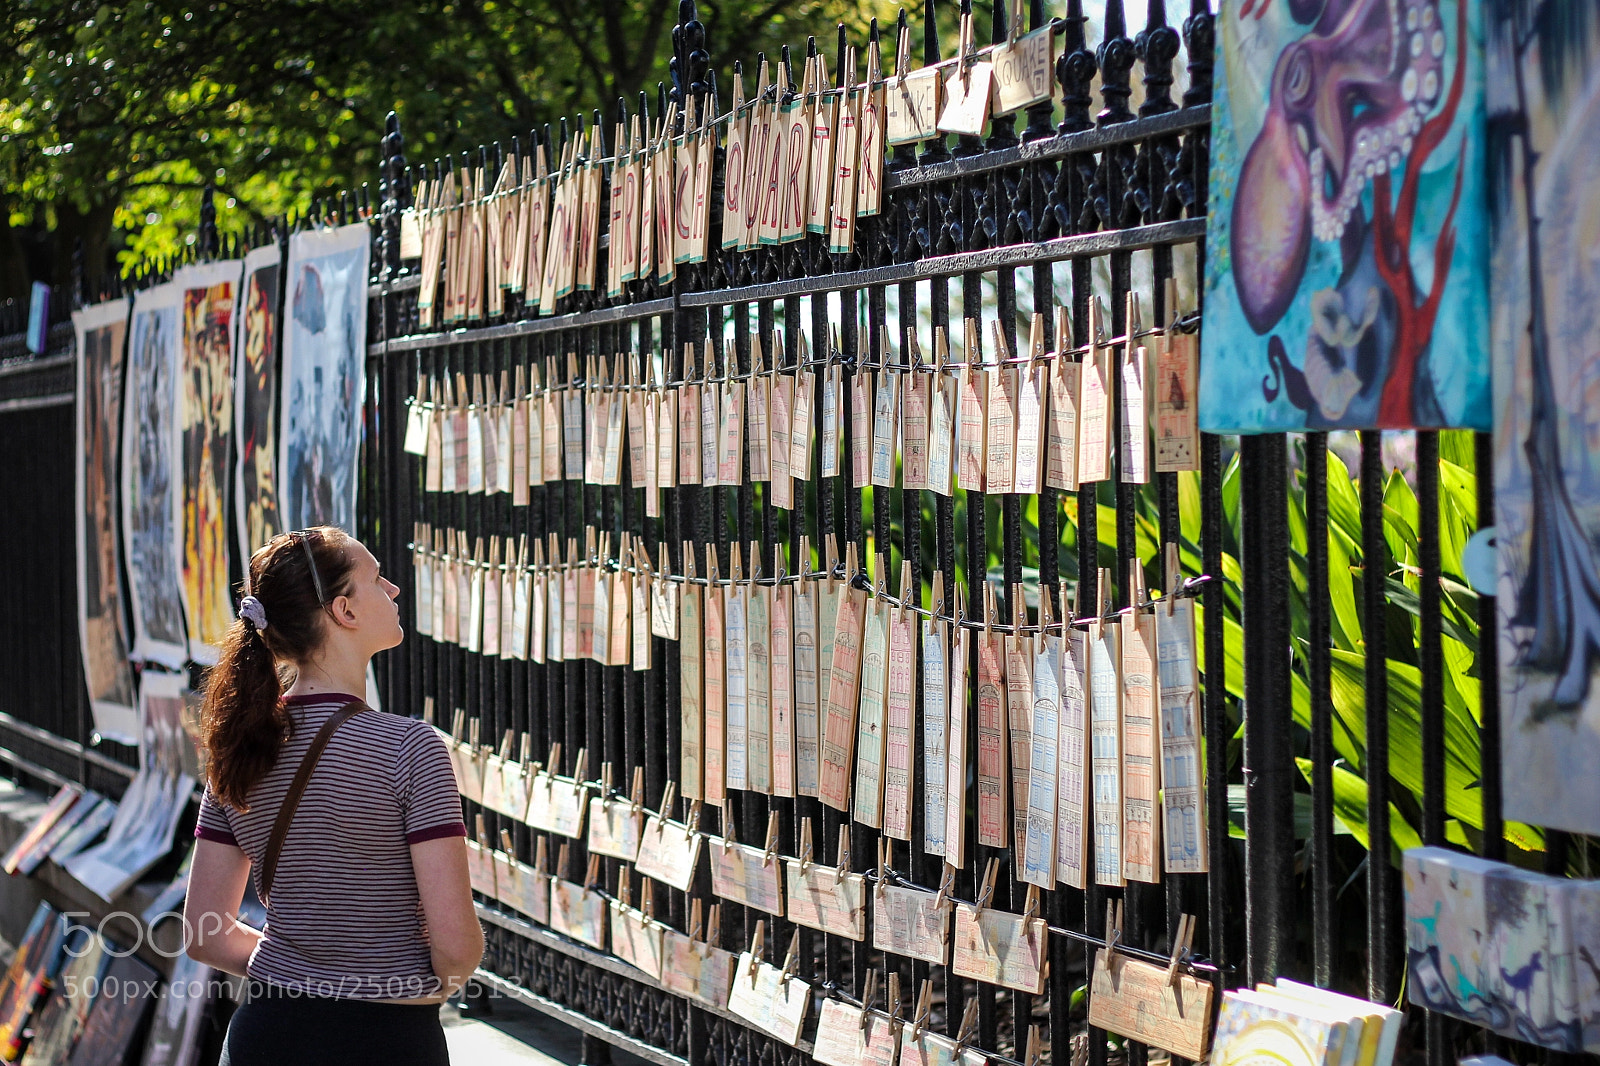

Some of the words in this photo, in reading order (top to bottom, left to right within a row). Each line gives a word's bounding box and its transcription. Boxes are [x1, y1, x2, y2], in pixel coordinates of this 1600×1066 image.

[995, 37, 1046, 94] SQUARE
[548, 199, 596, 287] OWN
[610, 161, 707, 268] FRENCH
[726, 102, 877, 230] QUARTER
